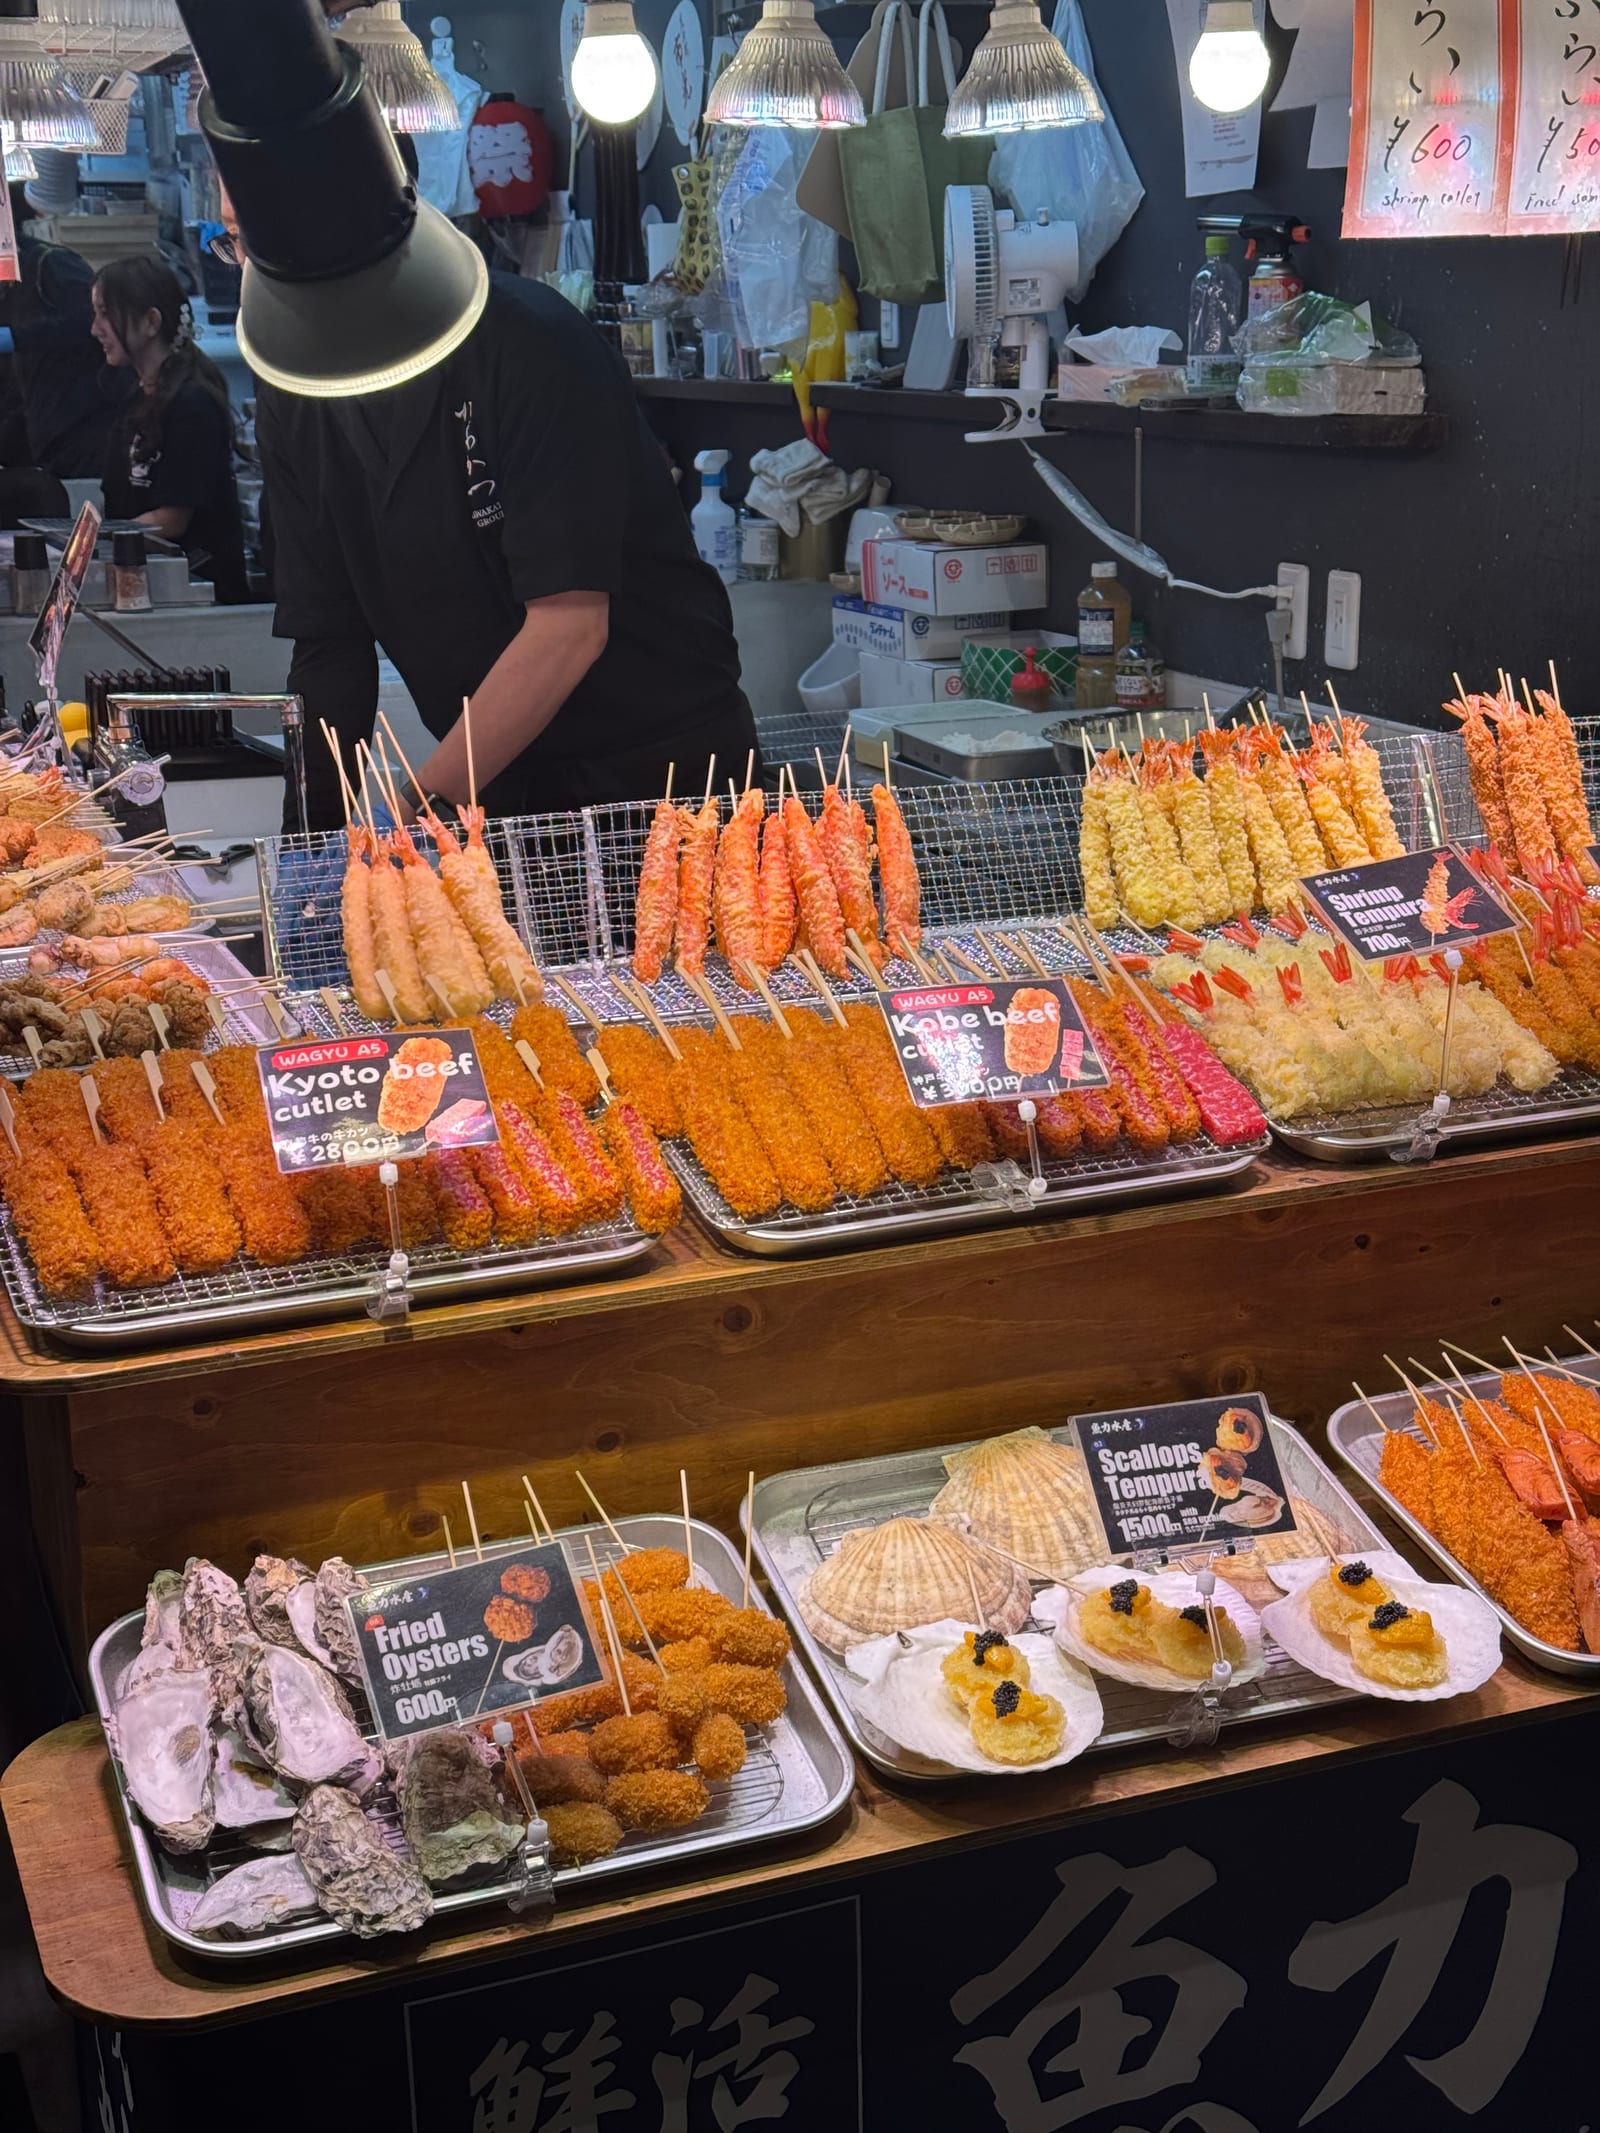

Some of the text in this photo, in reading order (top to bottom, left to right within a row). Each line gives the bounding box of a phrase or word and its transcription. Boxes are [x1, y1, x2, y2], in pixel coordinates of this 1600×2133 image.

[1328, 885, 1405, 913] Shrimp
[1338, 898, 1434, 929] Tempura
[1361, 933, 1411, 953] 700円
[898, 990, 989, 1009] WAGYU A5
[890, 1002, 1058, 1037] Kobe beef
[278, 1042, 381, 1067] WAGYU A5
[267, 1052, 474, 1099] Kyoto beef
[274, 1091, 367, 1123] cutlet
[1098, 1442, 1201, 1475] Scallops
[1104, 1468, 1212, 1501] Tempura
[1117, 1513, 1184, 1542] 1500円
[374, 1611, 446, 1654] Fried
[382, 1634, 489, 1682] Oysters
[394, 1689, 457, 1725] 600円
